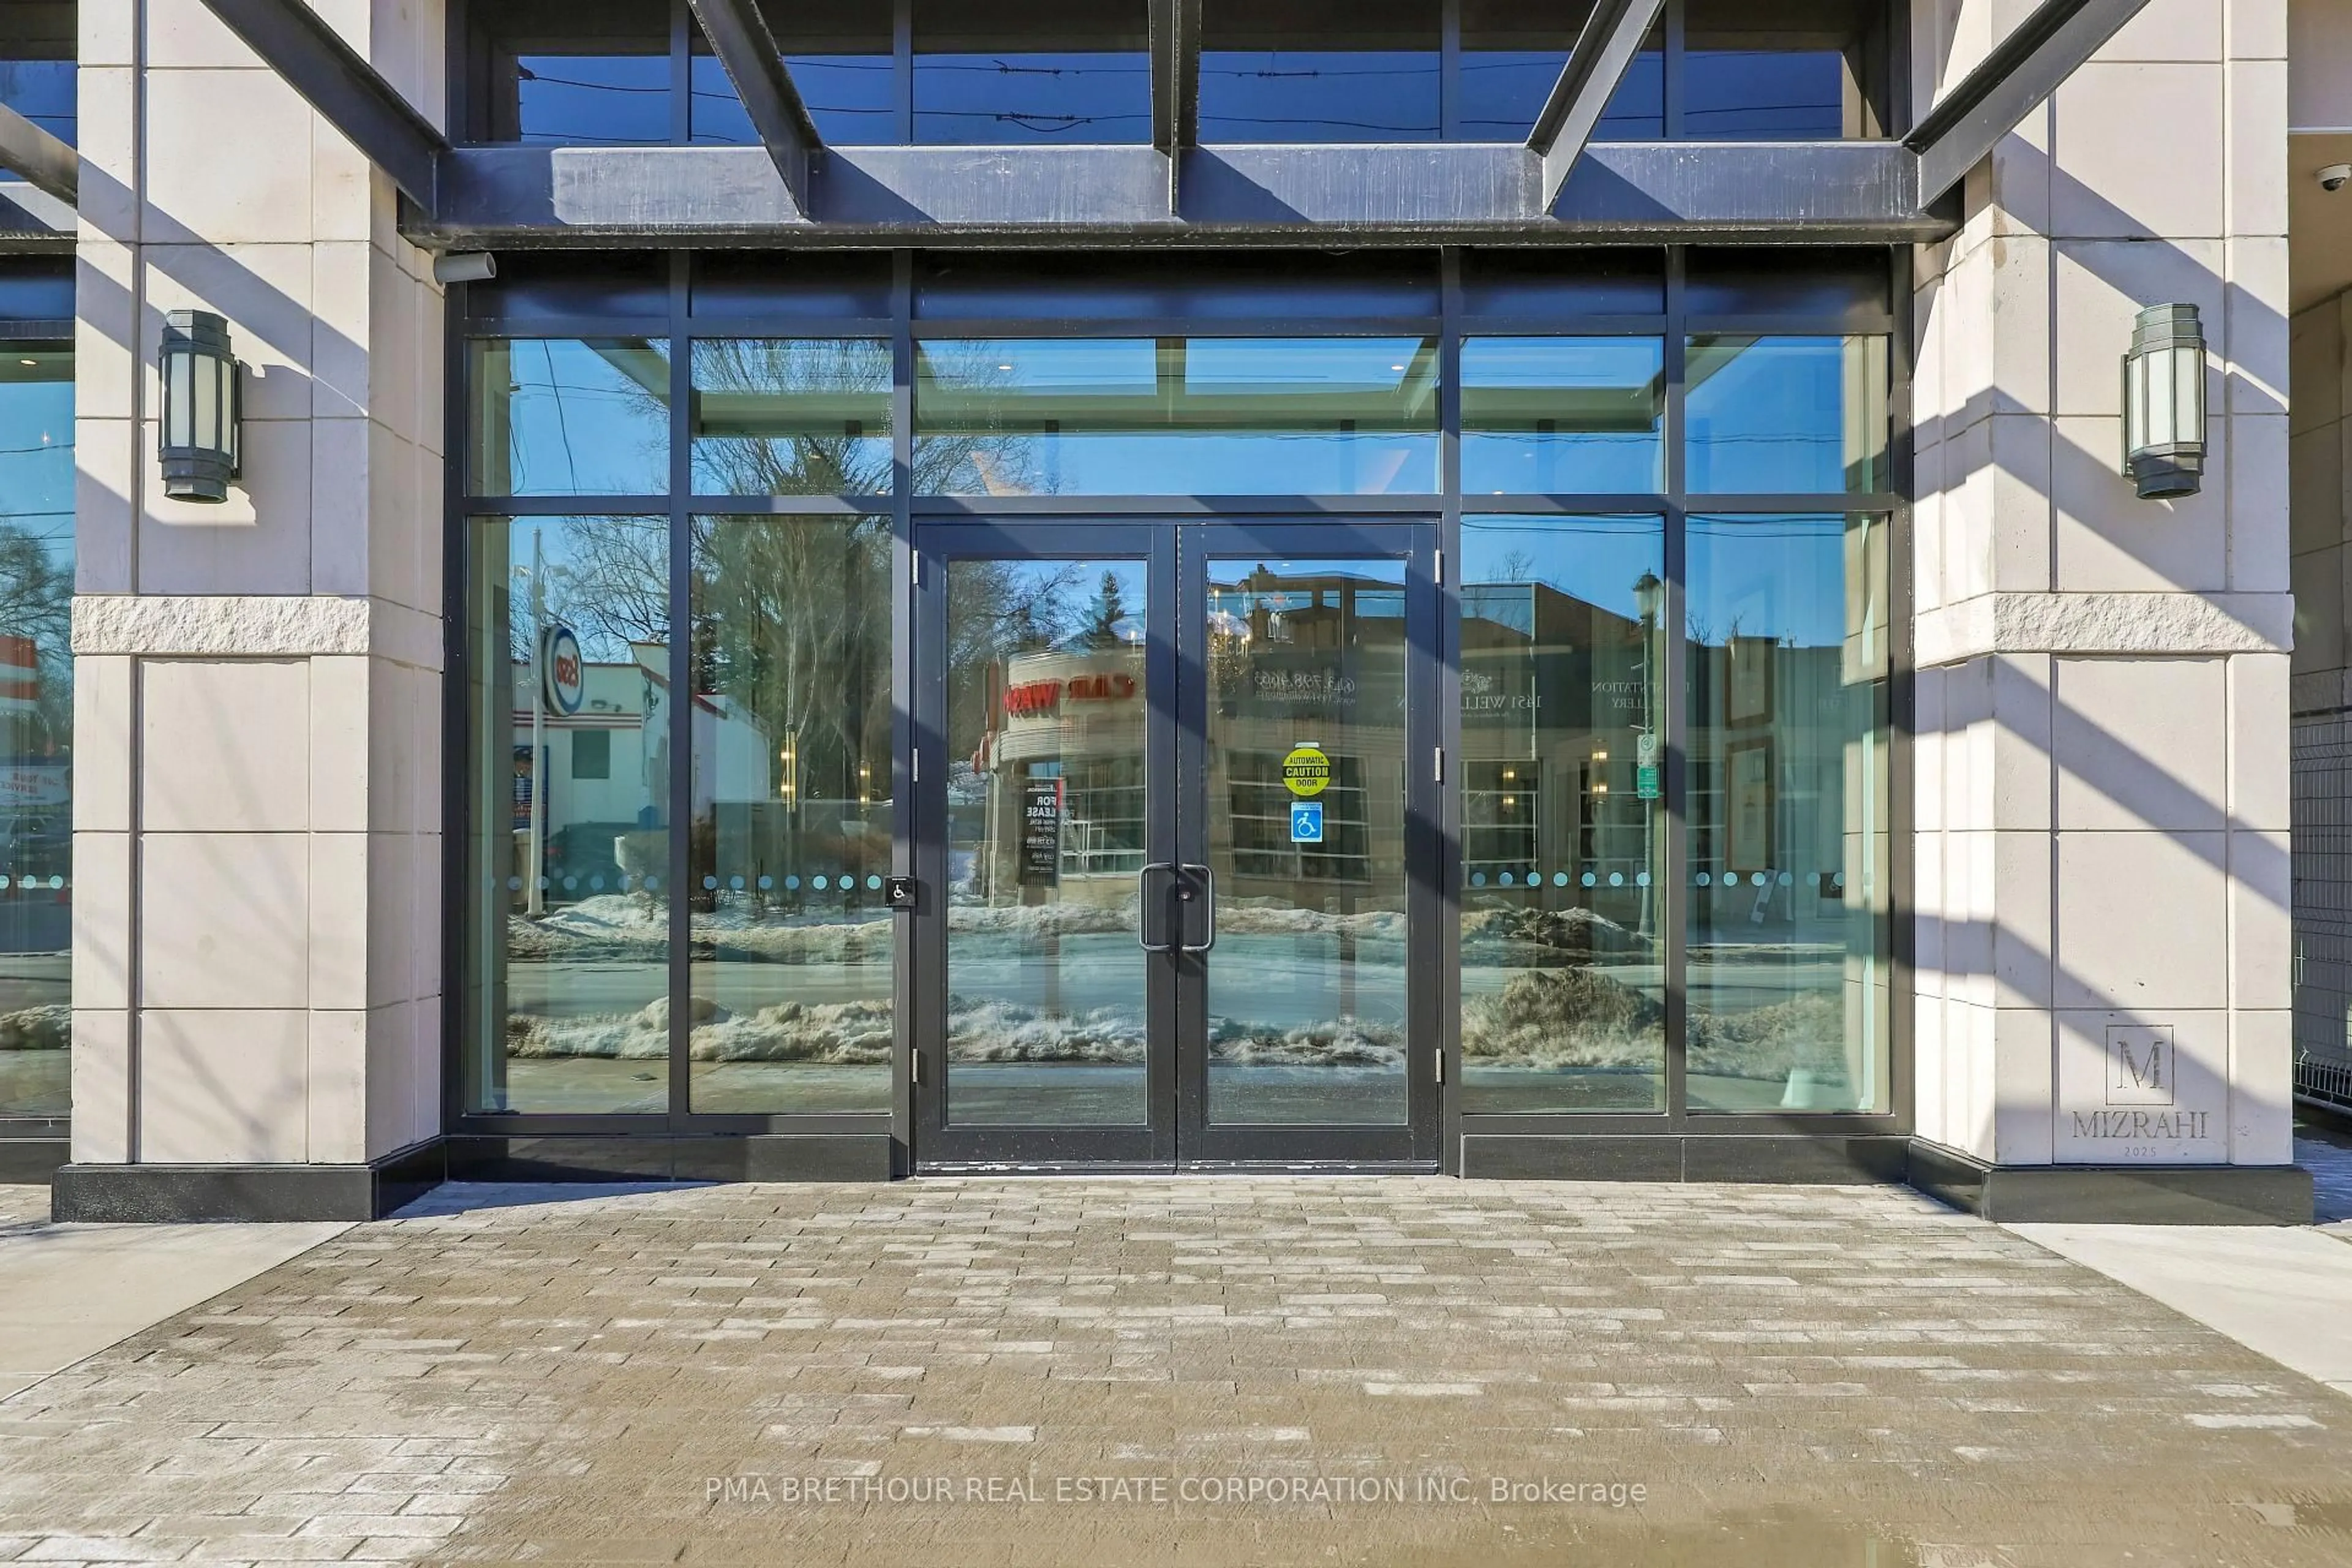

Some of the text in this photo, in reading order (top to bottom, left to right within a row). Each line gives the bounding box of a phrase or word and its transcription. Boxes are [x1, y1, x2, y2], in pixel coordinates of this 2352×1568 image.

[1286, 766, 1329, 777] CAUTION
[2117, 1041, 2165, 1089] M
[2073, 1111, 2209, 1139] MIZRAHI
[2124, 1147, 2157, 1158] 2025
